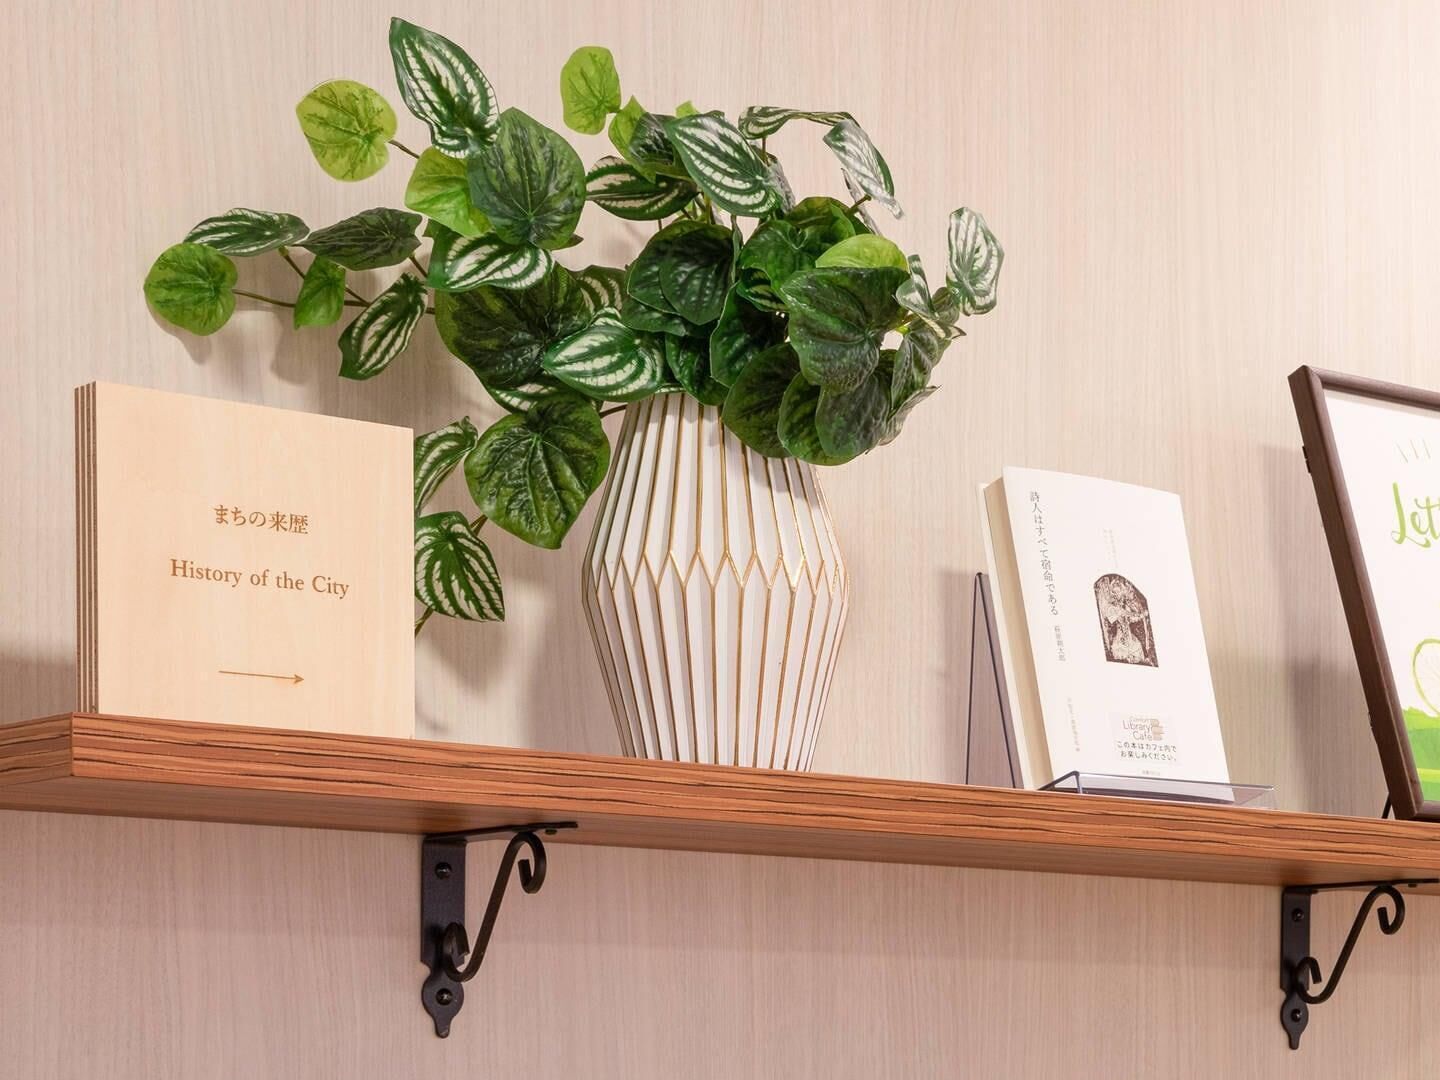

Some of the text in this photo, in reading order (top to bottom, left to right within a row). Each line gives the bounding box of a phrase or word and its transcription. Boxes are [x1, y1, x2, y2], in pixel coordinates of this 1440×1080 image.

[214, 504, 309, 534] まちの来歴
[170, 559, 350, 599] History of the City
[1122, 720, 1152, 733] Library
[1117, 741, 1177, 753] この本はカフェ内で
